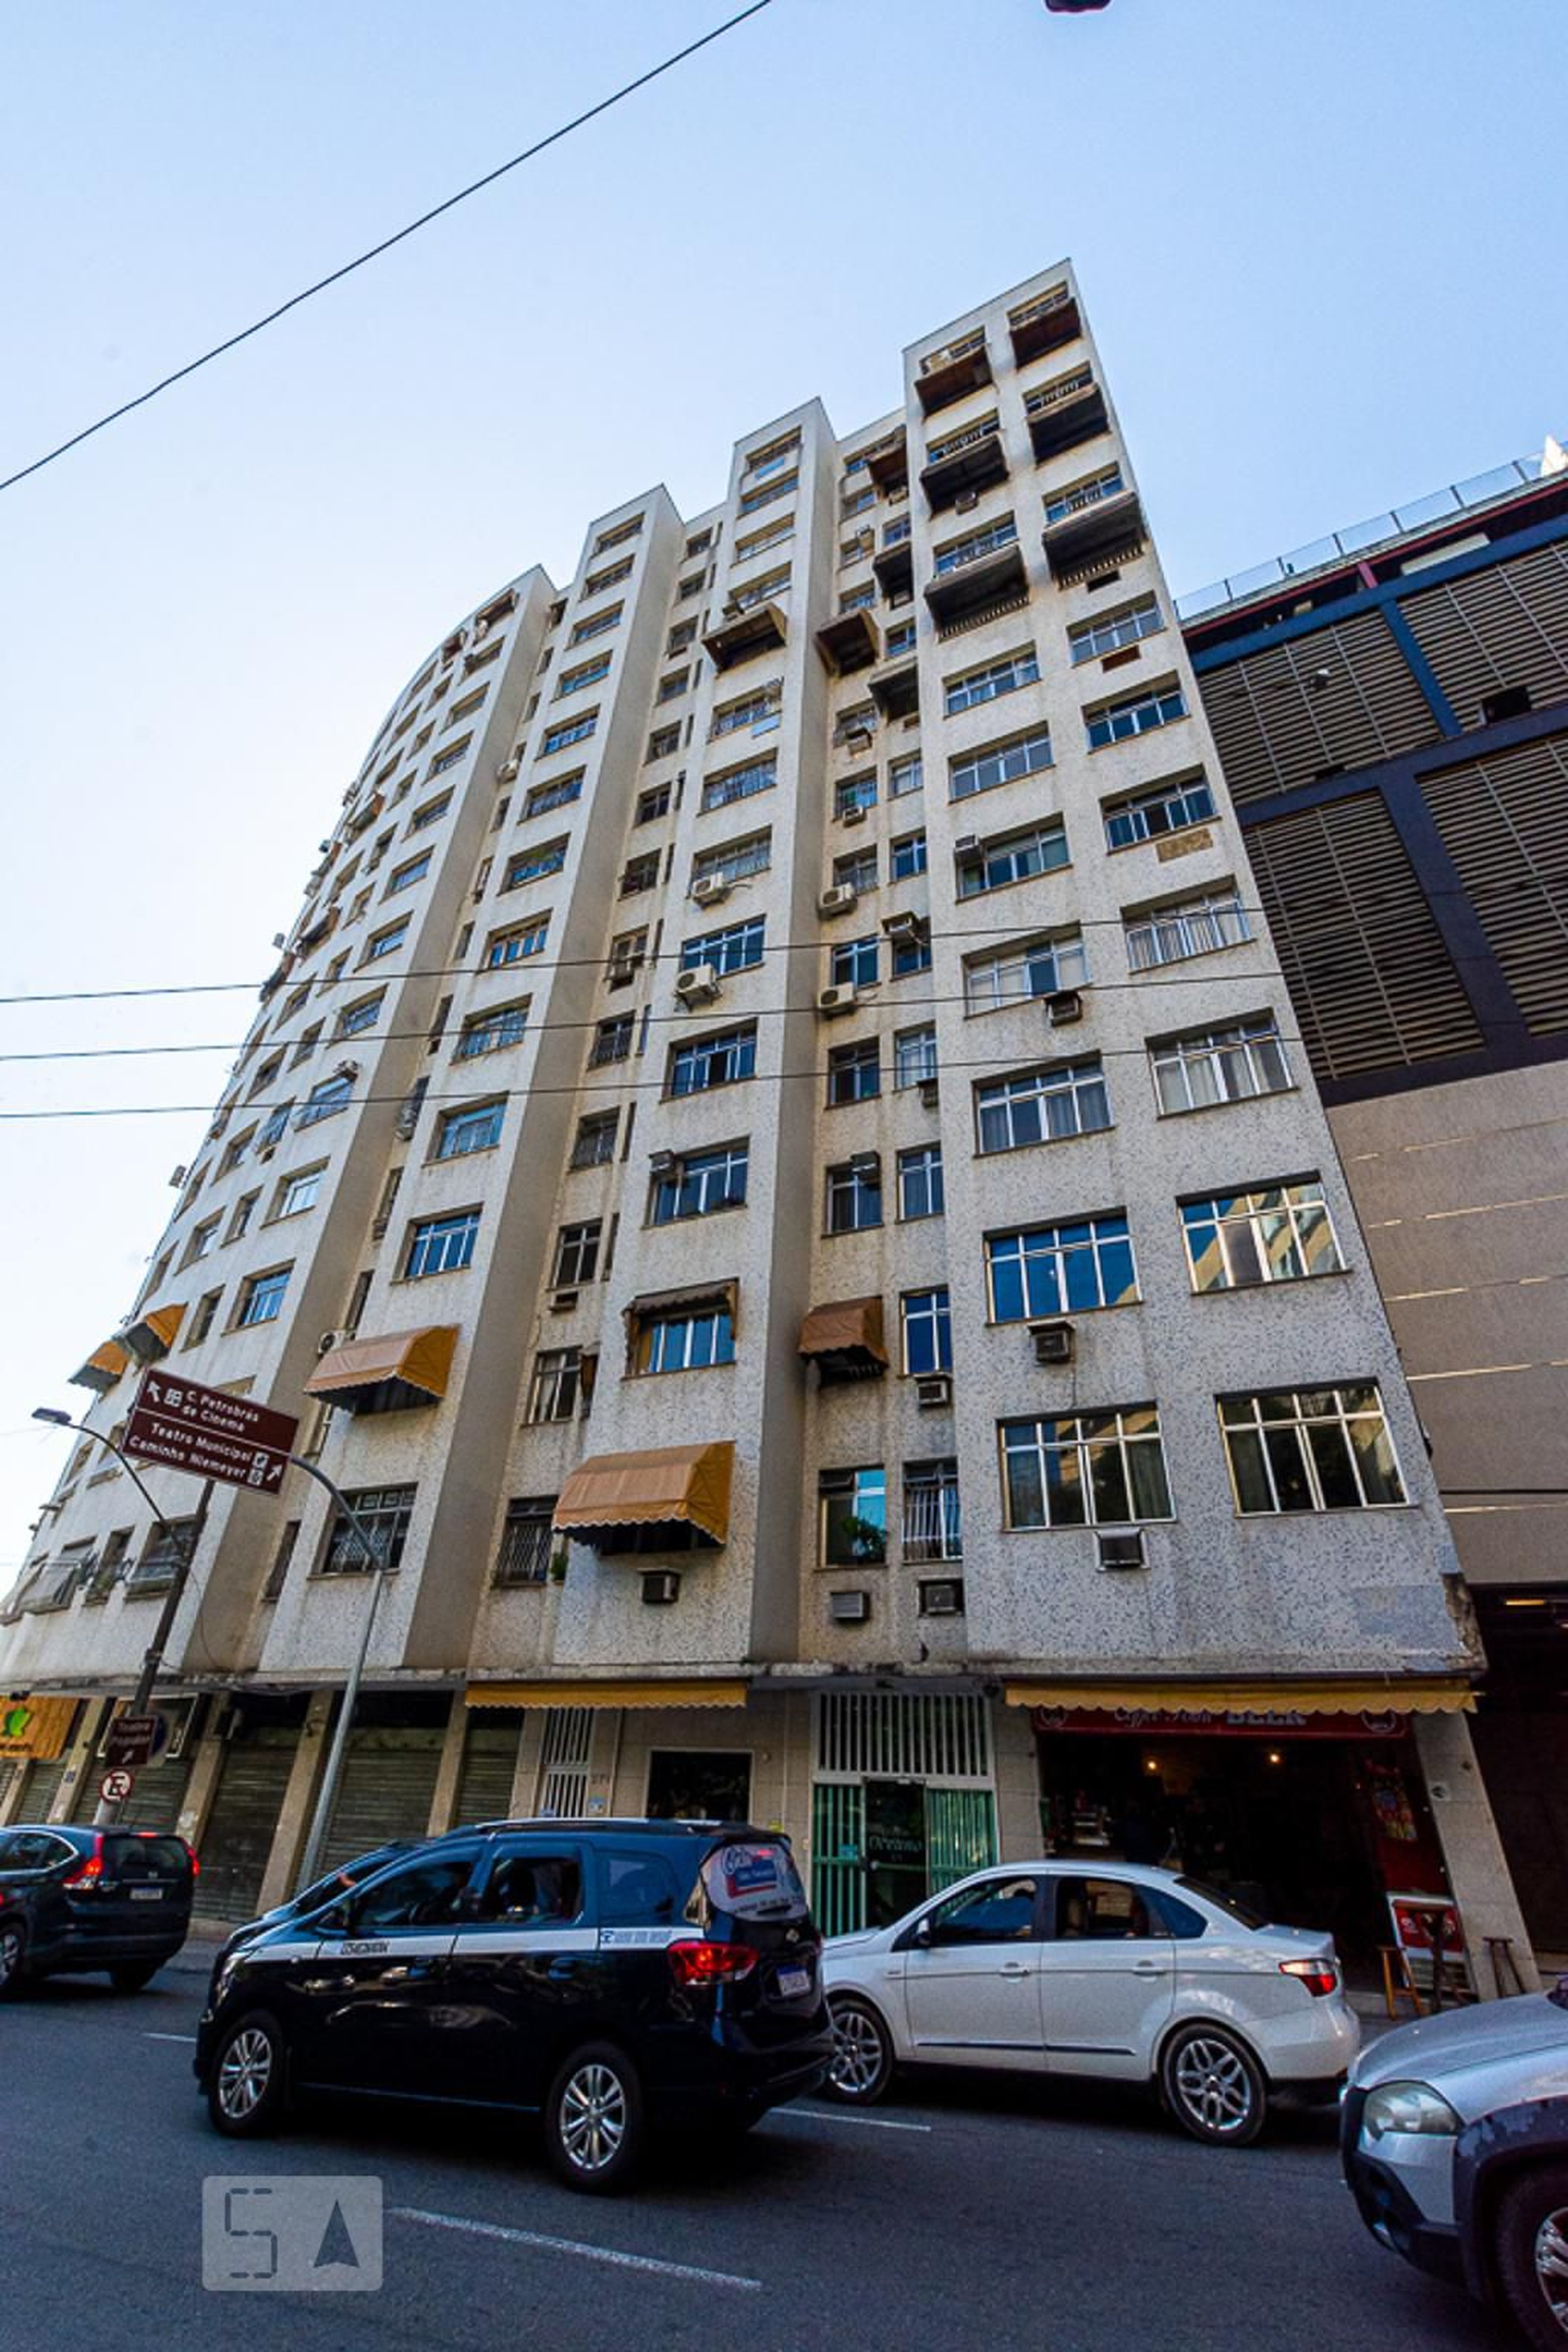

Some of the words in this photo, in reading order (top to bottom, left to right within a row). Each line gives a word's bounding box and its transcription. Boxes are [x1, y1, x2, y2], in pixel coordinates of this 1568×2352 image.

[183, 1405, 197, 1417] de
[200, 1410, 245, 1432] Cinema
[129, 1434, 185, 1460] Caminho
[189, 1452, 246, 1476] Niemeyer
[151, 1421, 193, 1444] Teatro
[195, 1436, 253, 1462] Municipal
